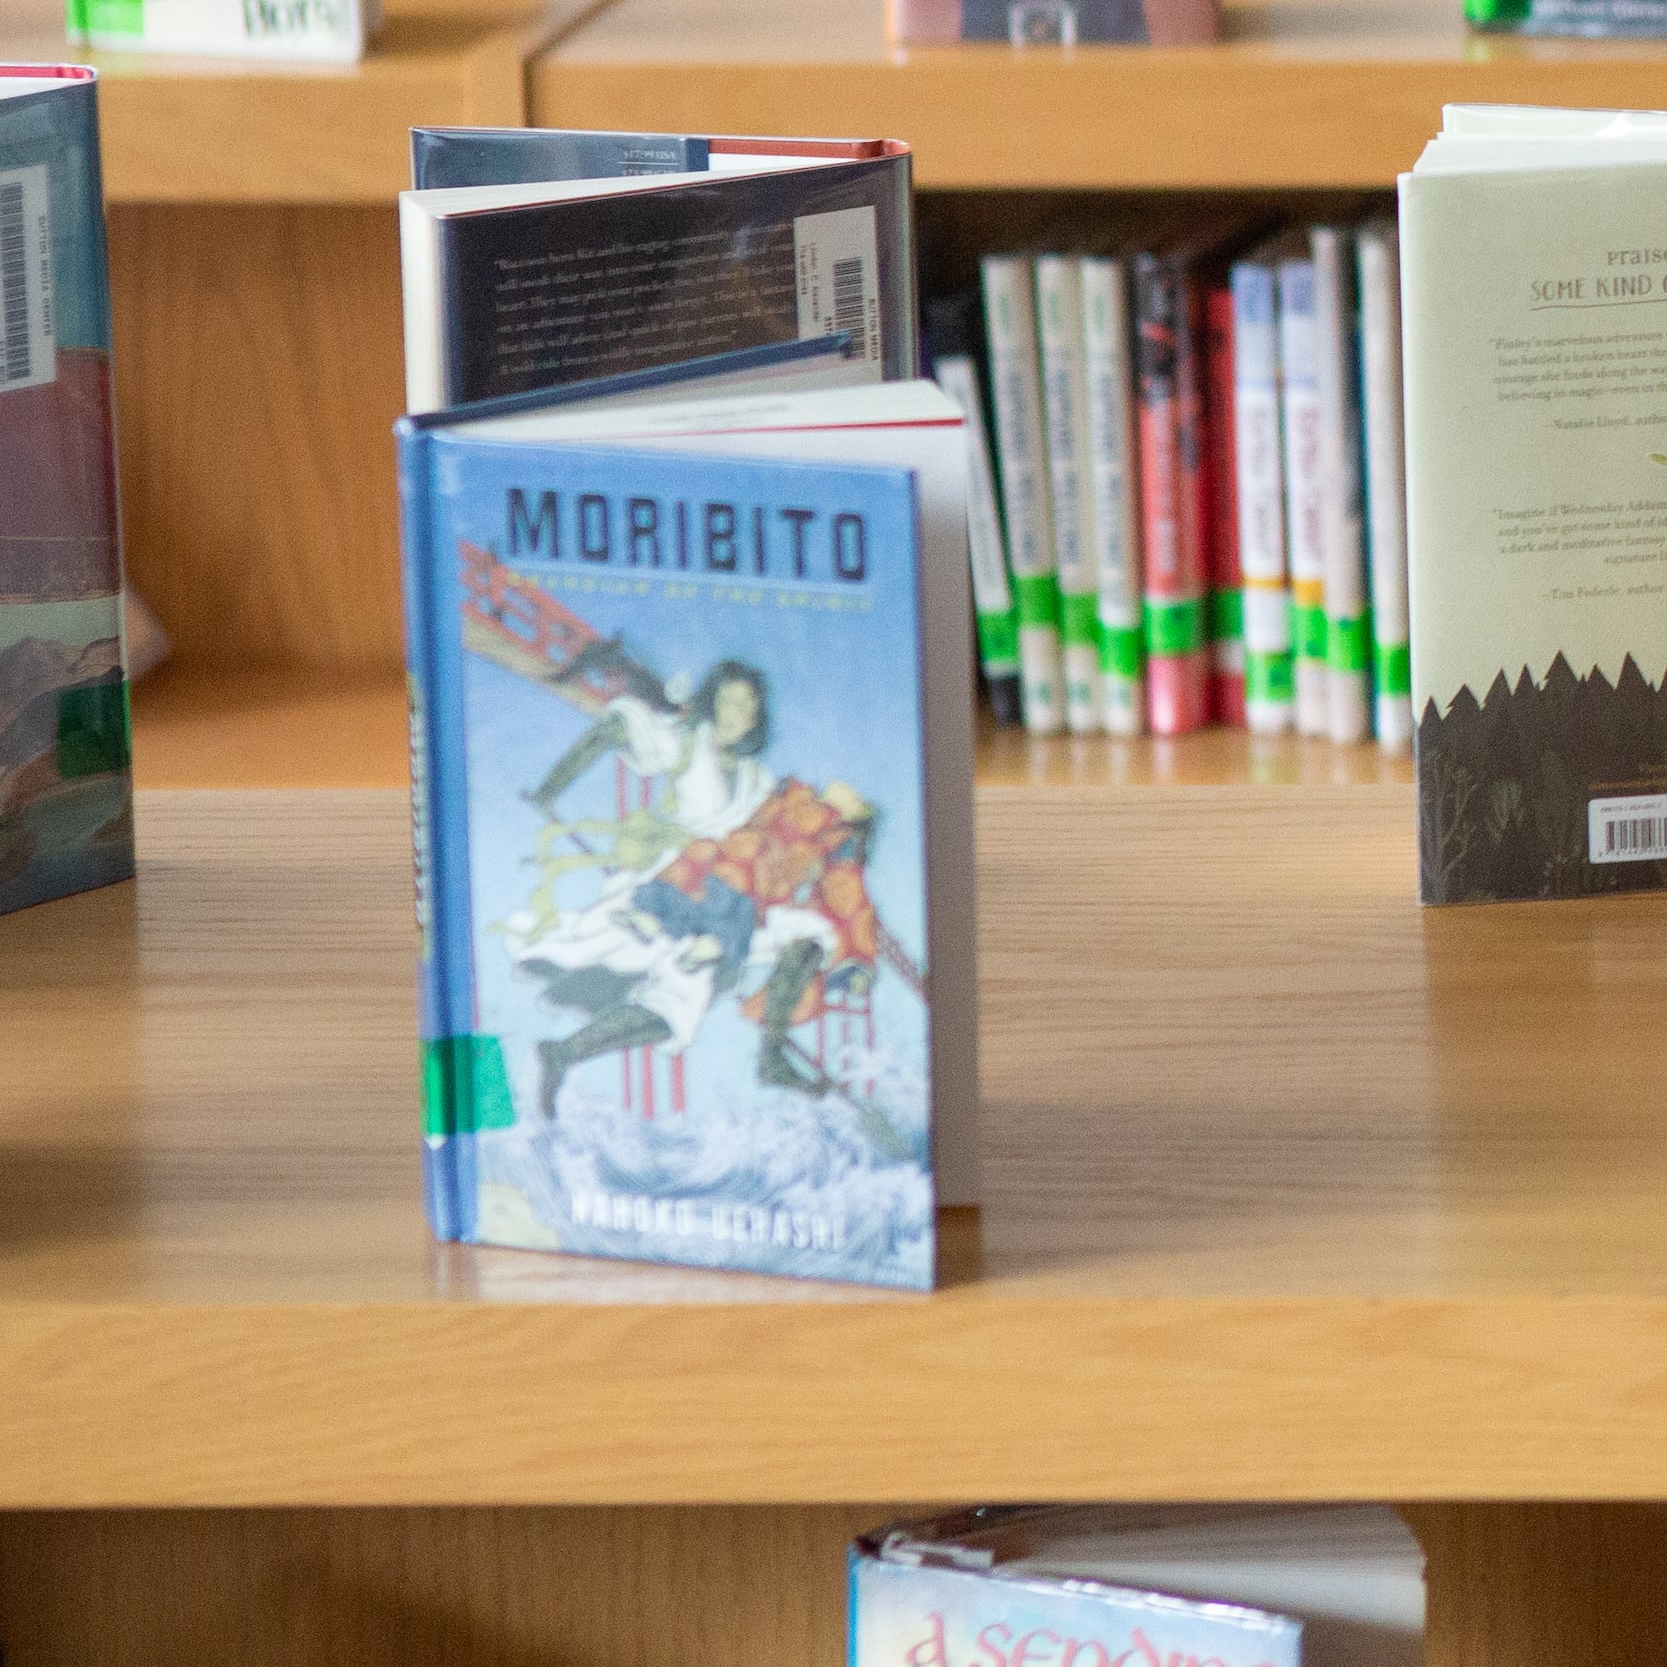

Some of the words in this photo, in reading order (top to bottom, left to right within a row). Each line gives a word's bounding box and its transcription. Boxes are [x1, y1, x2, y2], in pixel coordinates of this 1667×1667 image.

[1530, 277, 1588, 303] SOME
[1594, 272, 1654, 299] KIND
[505, 486, 867, 582] MORIBITO
